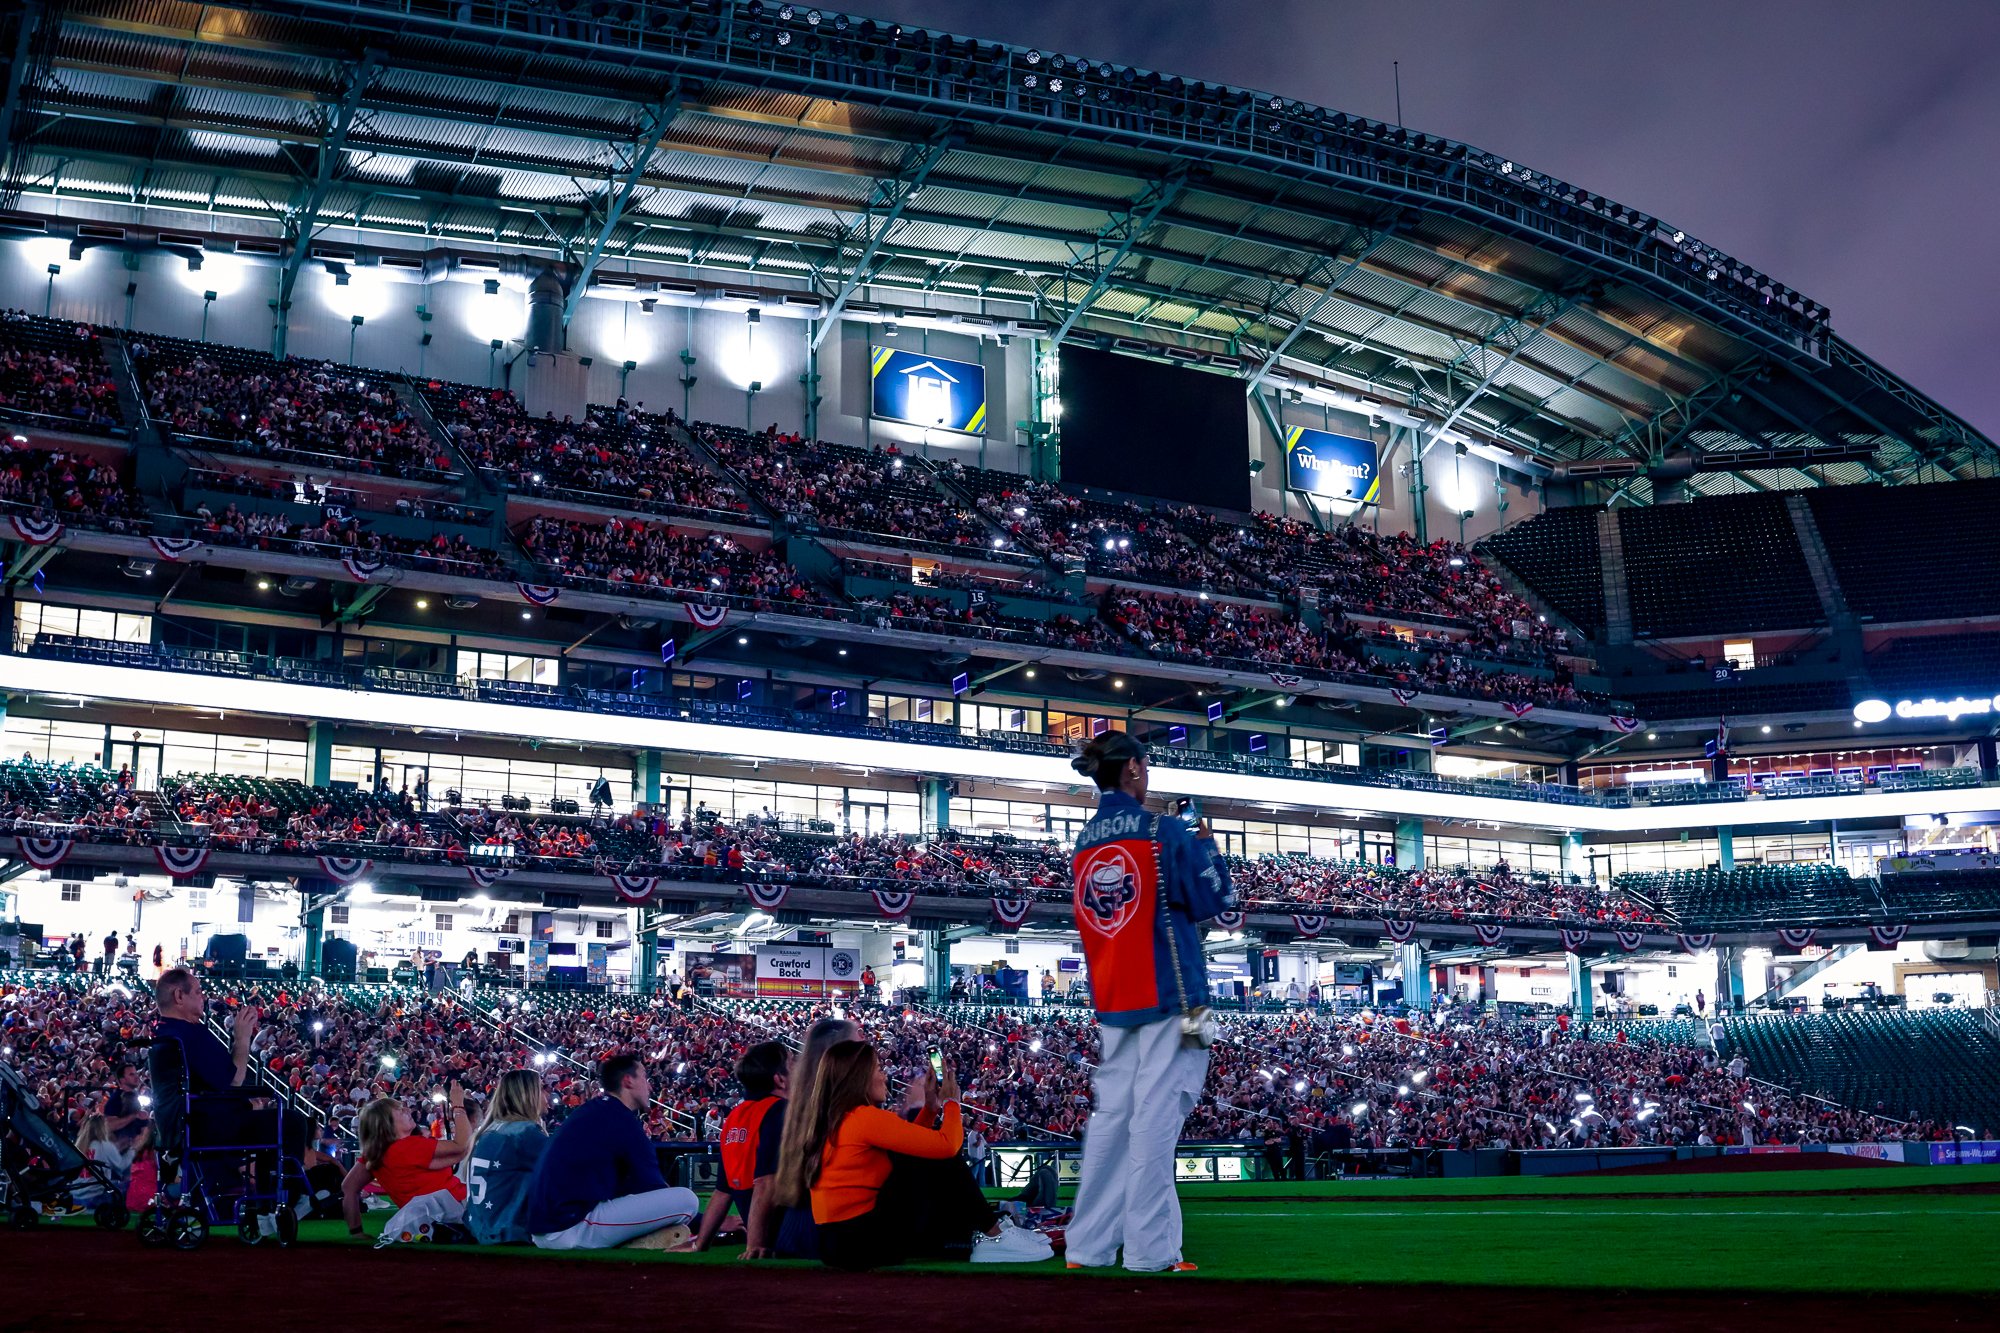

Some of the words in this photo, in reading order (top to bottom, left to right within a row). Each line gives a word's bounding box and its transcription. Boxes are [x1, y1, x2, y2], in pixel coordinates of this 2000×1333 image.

[971, 592, 984, 602] 15
[1715, 669, 1728, 679] 20
[770, 957, 811, 969] Crawford
[779, 968, 802, 978] Bock
[1856, 1145, 1882, 1158] ARROW
